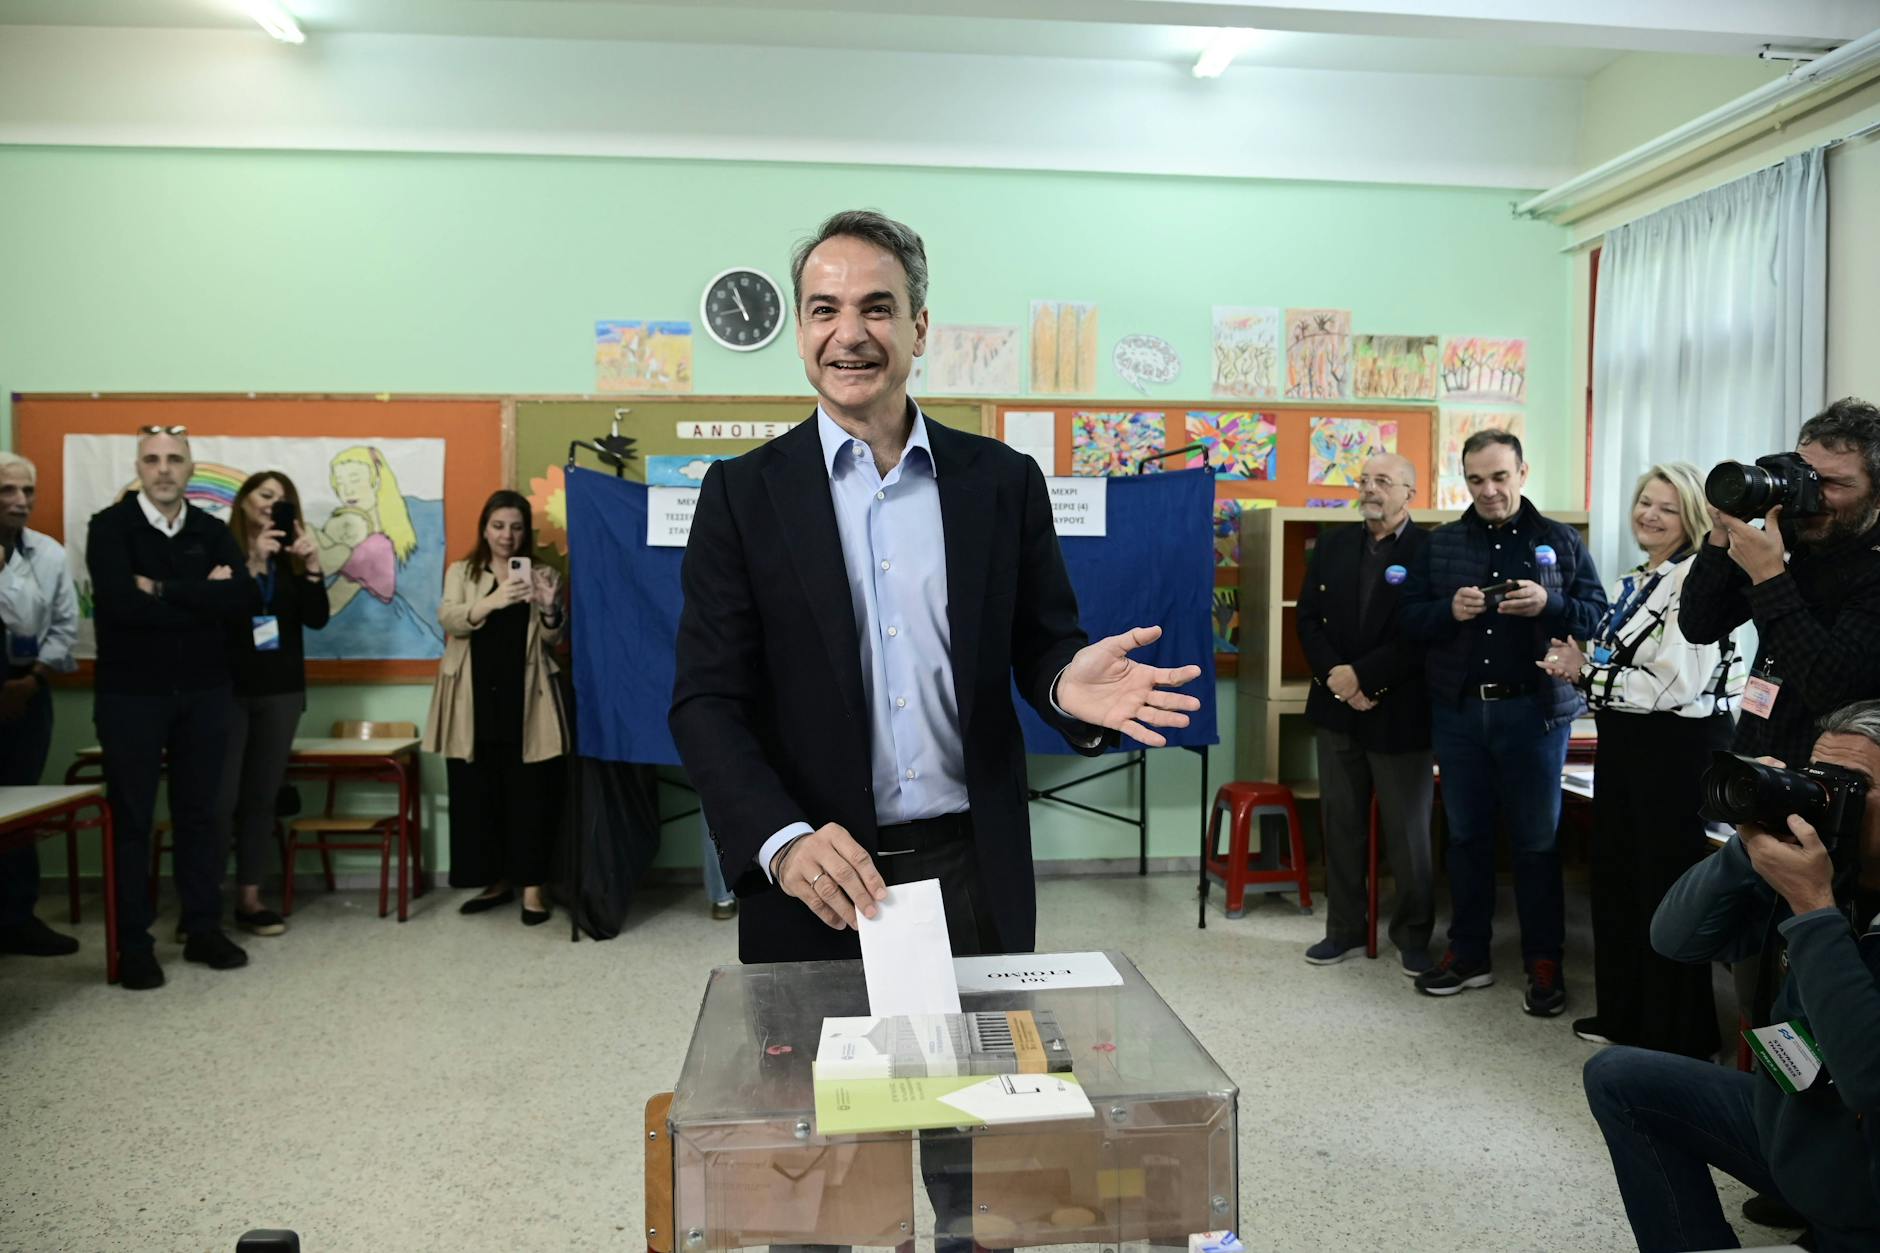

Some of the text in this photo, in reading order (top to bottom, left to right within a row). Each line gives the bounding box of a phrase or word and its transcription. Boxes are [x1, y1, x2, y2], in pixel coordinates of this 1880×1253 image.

[1051, 488, 1078, 496] ΜΕΧΡΙ
[1077, 503, 1089, 512] (4)
[1808, 768, 1825, 776] SONY
